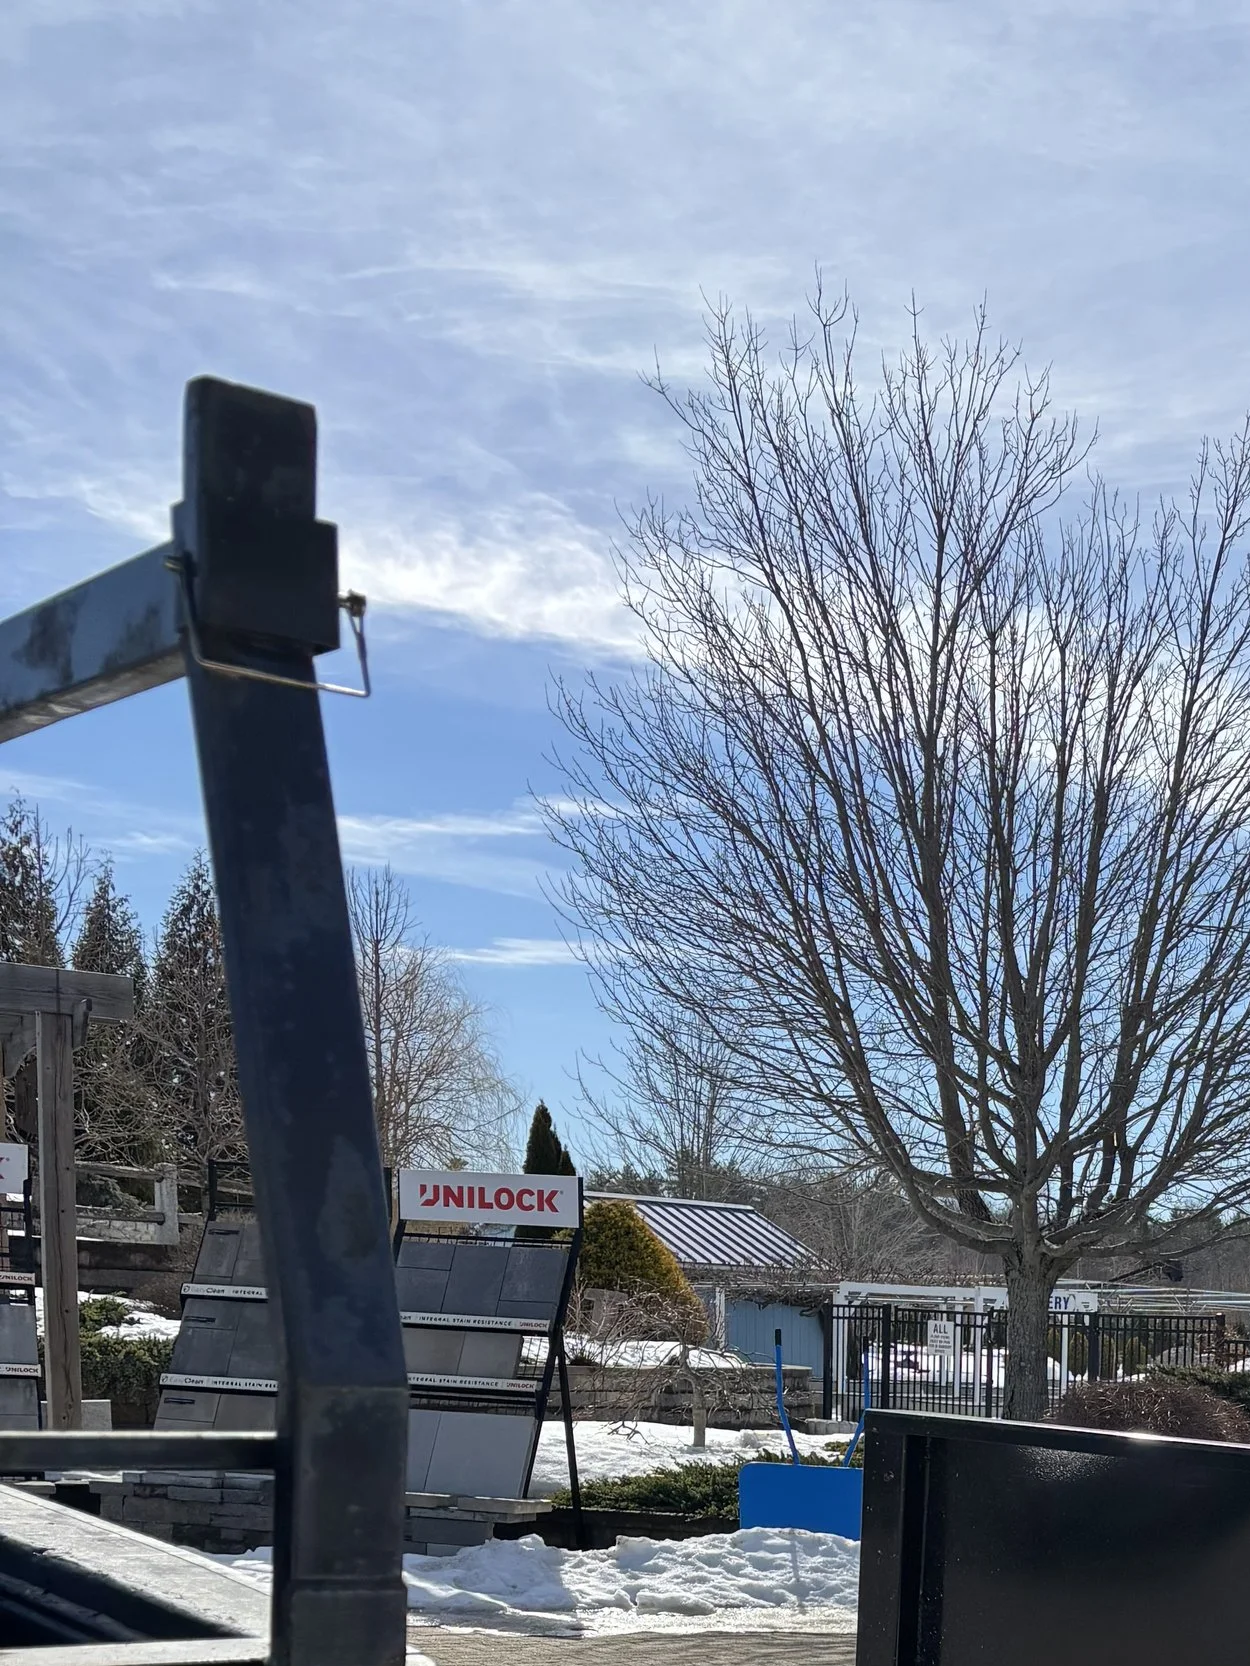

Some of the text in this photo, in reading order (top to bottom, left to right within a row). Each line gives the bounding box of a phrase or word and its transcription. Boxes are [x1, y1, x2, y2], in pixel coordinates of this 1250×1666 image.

[420, 1184, 560, 1213] UNILOCK
[519, 1321, 548, 1329] UNILOCK
[933, 1323, 949, 1335] ALL
[408, 1376, 437, 1384] NTEGRAL
